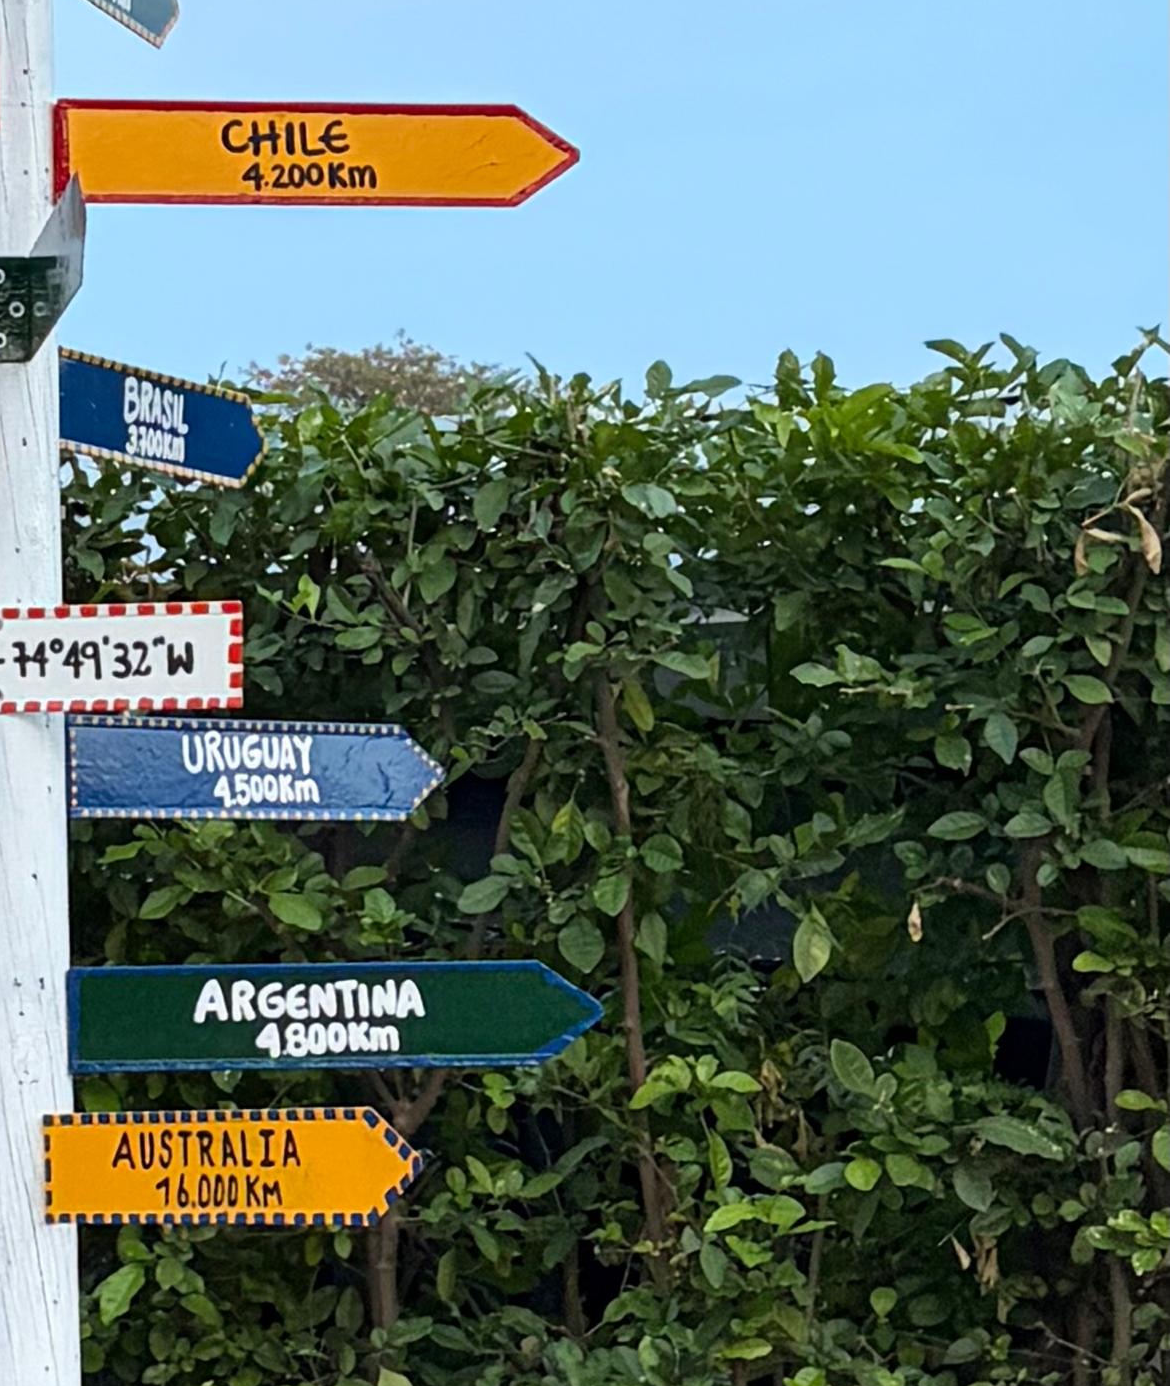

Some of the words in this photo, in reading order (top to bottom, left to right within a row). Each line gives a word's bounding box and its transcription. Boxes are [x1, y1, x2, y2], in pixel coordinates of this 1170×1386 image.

[221, 119, 350, 156] CHILE
[123, 376, 189, 434] BRASIL
[182, 730, 313, 775] URUGUAY
[193, 978, 426, 1023] ARGENTINA
[112, 1129, 301, 1169] AUSTRALIA
